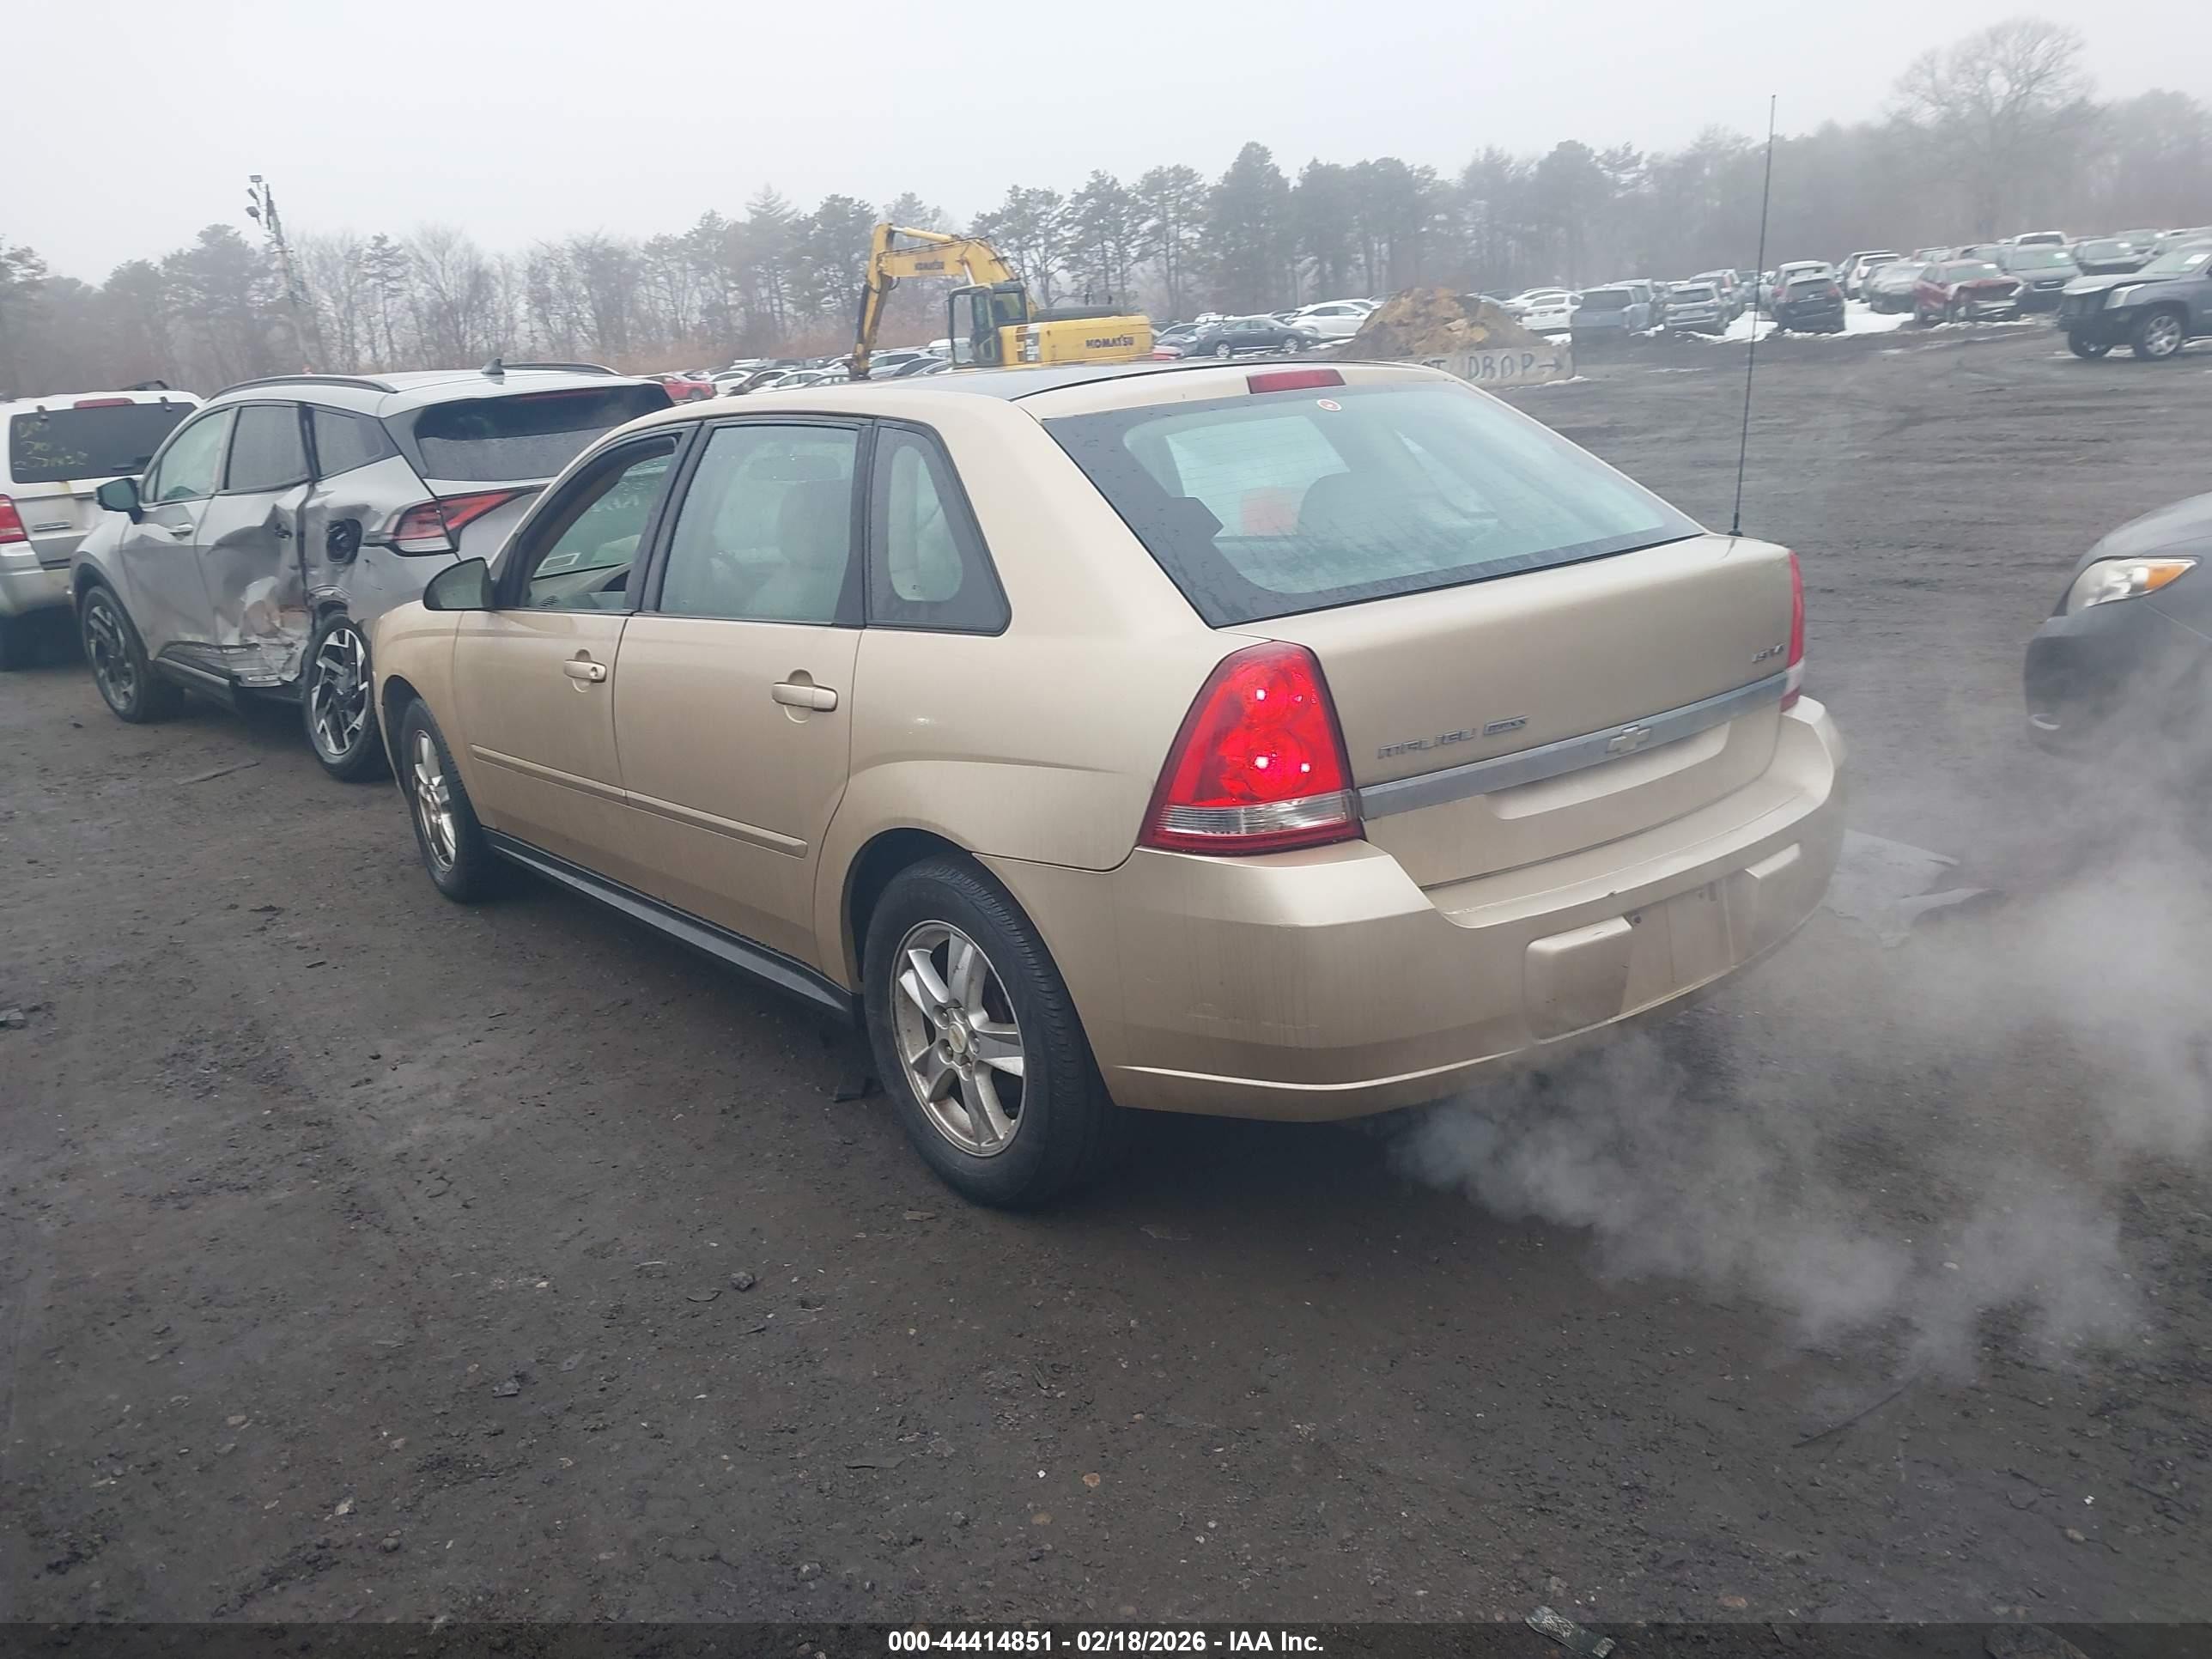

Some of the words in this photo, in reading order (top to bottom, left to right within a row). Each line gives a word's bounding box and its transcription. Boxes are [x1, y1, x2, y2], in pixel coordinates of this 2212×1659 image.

[1085, 335, 1134, 349] KOMATSU
[1467, 352, 1535, 380] DROP
[1376, 728, 1477, 760] MALIBU
